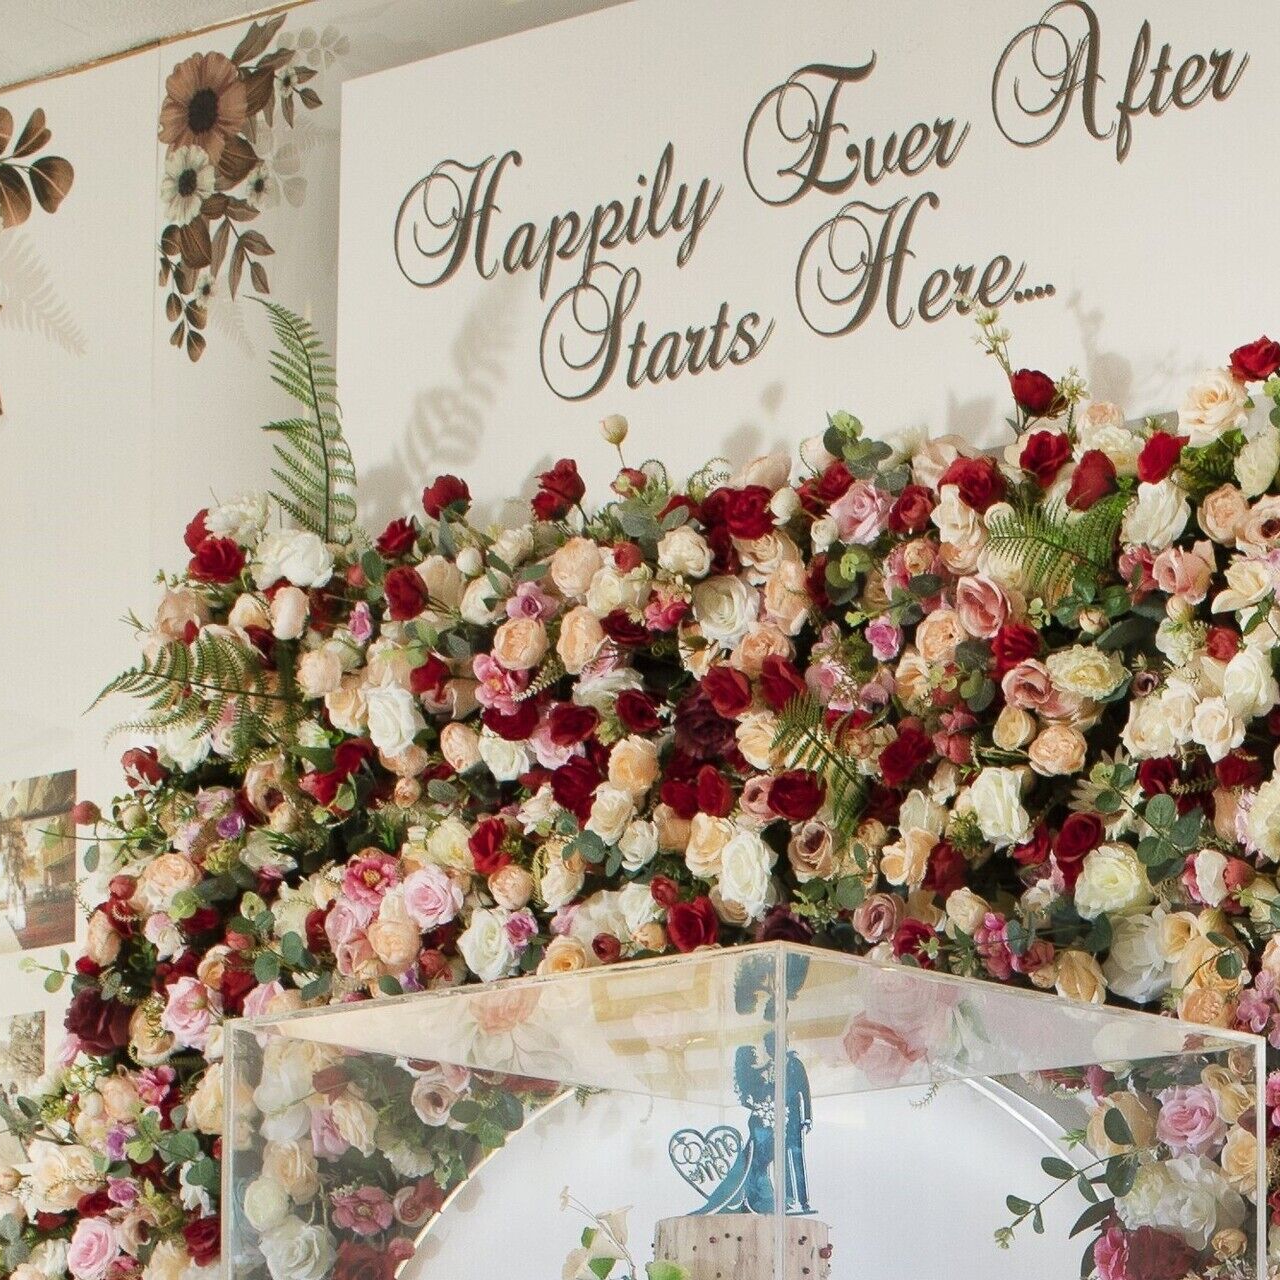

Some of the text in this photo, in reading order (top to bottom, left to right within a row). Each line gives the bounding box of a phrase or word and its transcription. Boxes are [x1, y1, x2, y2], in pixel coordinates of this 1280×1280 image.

[394, 0, 1251, 302] Happily Ever After
[539, 261, 777, 402] Starts
